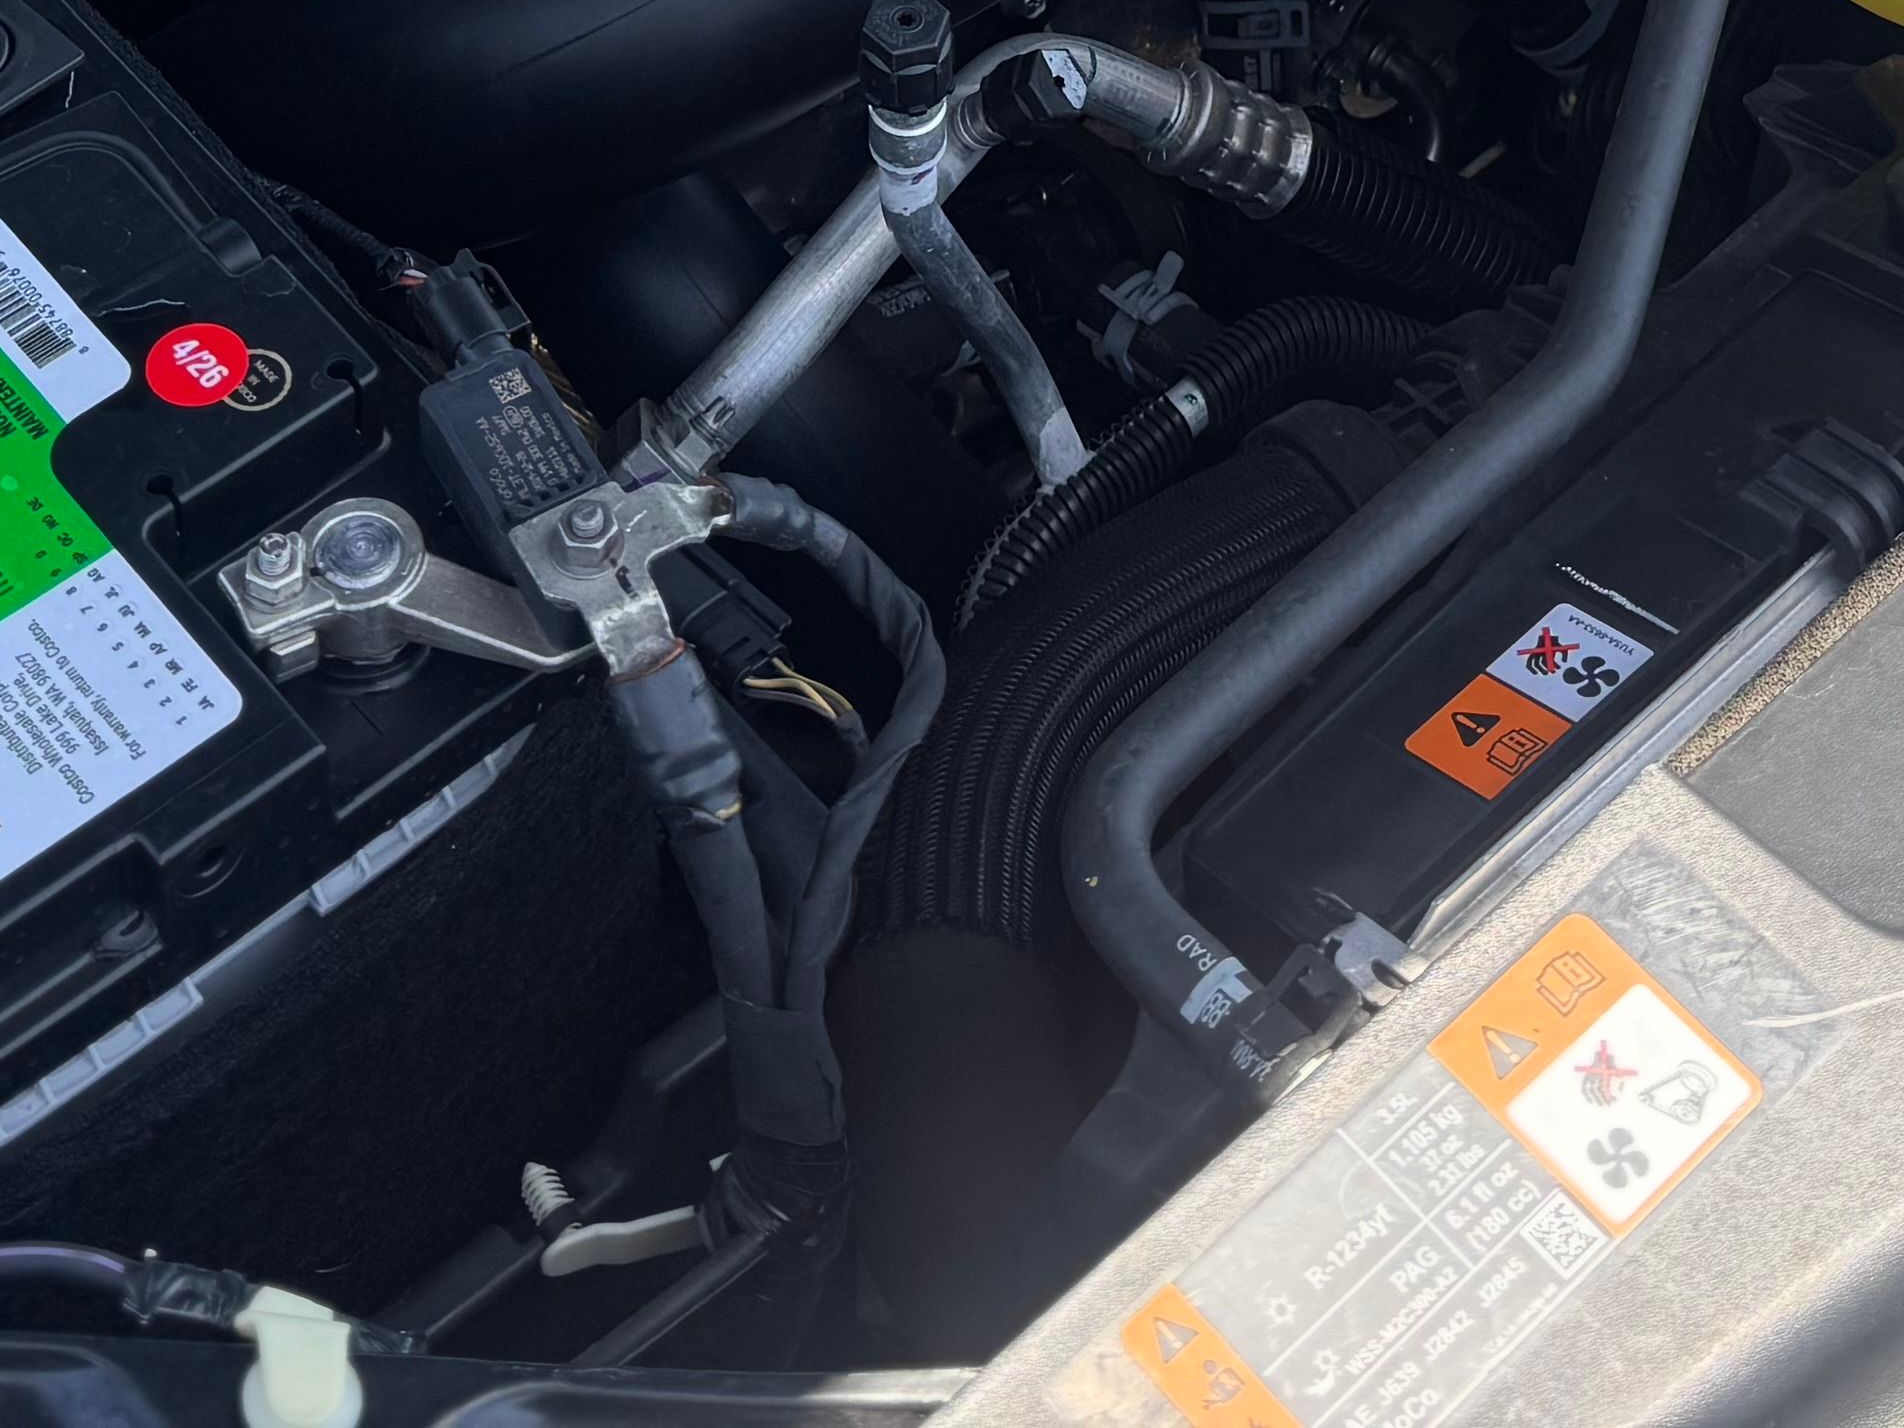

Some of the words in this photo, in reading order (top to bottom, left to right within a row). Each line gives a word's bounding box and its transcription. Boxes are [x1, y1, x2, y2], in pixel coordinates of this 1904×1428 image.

[173, 339, 229, 388] 4/26
[254, 360, 279, 384] MADE
[33, 548, 47, 559] 0
[48, 566, 63, 578] 9
[64, 584, 79, 596] 8
[79, 602, 94, 614] 7
[22, 617, 61, 659] Costco.
[95, 621, 110, 633] 6
[111, 640, 125, 652] 5
[14, 648, 51, 687] 98027
[53, 654, 71, 670] to
[127, 658, 142, 671] 4
[7, 671, 43, 707] Drive,
[42, 681, 68, 706] WA
[62, 665, 96, 700] return
[142, 677, 157, 689] 3
[158, 695, 173, 708] 2
[32, 702, 63, 733] Lake
[59, 698, 111, 755] Issaquah,
[86, 692, 133, 742] warranty,
[174, 714, 188, 726] 1
[10, 708, 64, 768] Wholesale
[54, 728, 81, 755] 999
[122, 736, 147, 760] For
[55, 761, 96, 806] Costco
[1174, 929, 1218, 973] RAD
[1375, 1087, 1418, 1127] 3.5L
[1428, 1099, 1465, 1135] kg
[1438, 1132, 1464, 1157] oz
[1458, 1140, 1487, 1167] lbs
[1488, 1160, 1519, 1190] oz
[1464, 1205, 1514, 1252] (180
[1502, 1177, 1543, 1216] cc)
[1303, 1203, 1398, 1292] R-1234yf
[1388, 1242, 1442, 1293] PAG
[1372, 1359, 1423, 1407] J639
[1417, 1308, 1476, 1363] J2842
[1471, 1255, 1529, 1309] J2845
